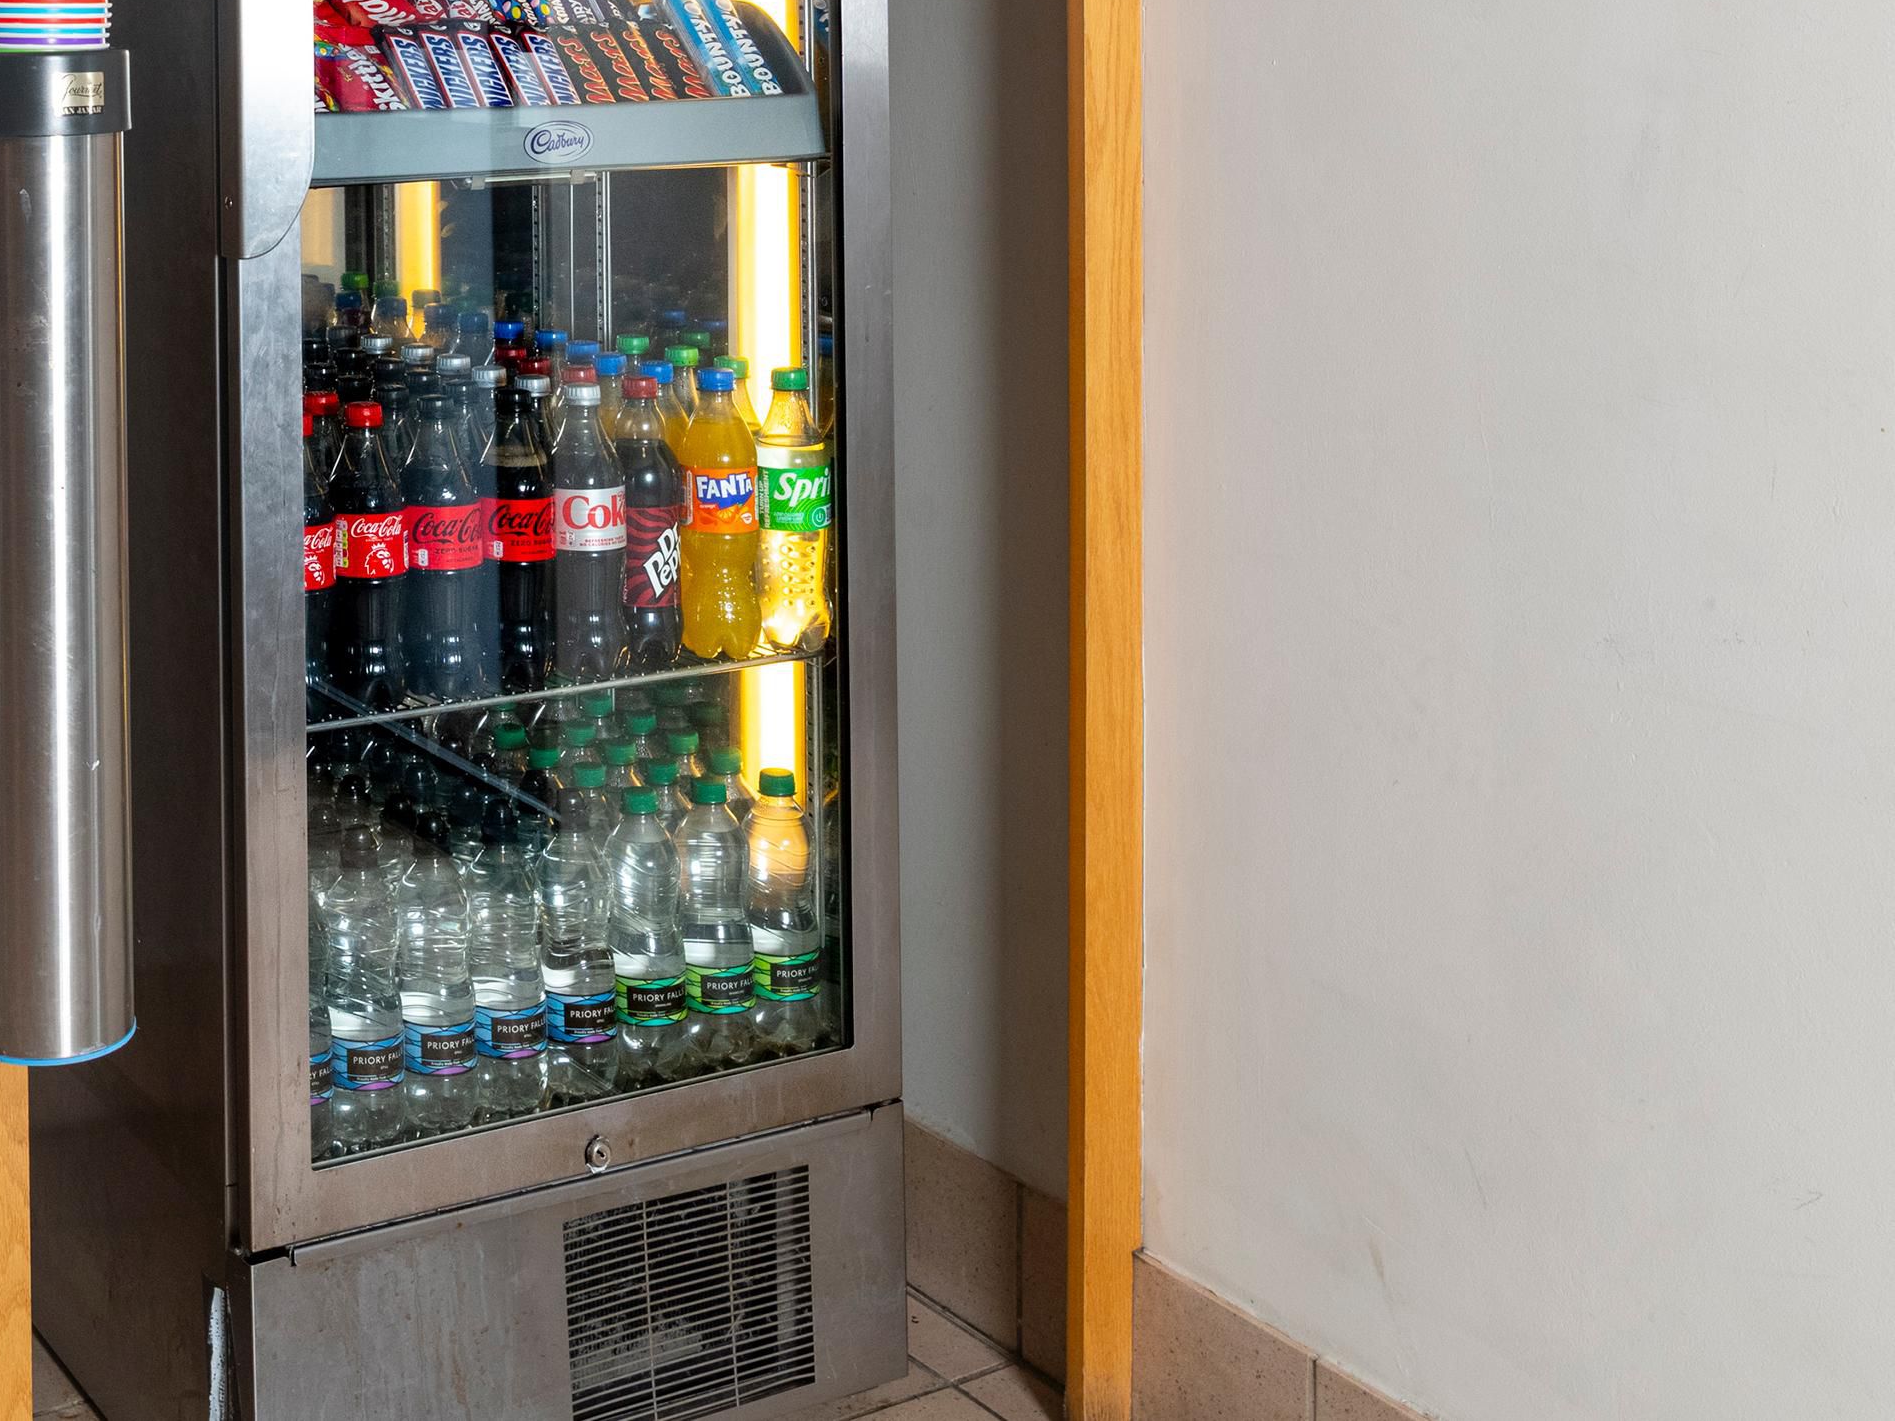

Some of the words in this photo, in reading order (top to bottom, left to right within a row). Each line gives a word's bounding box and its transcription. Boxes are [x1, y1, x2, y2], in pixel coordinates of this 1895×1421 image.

[690, 17, 752, 97] BOUNTY
[722, 12, 785, 97] BOUNTY
[557, 36, 616, 104] Mars
[590, 31, 649, 102] Mars
[623, 30, 678, 100] Mars
[531, 129, 585, 156] Cadbury
[696, 473, 753, 499] FANTA
[759, 480, 764, 493] UP
[351, 514, 403, 538] Coca-Cola
[777, 968, 806, 979] PRIORY
[707, 980, 738, 991] PRIORY
[633, 992, 664, 1002] PRIORY
[570, 1010, 601, 1019] PRIORY
[497, 1024, 529, 1034] PRIORY
[427, 1040, 459, 1050] PRIORY
[353, 1054, 385, 1065] PRIORY
